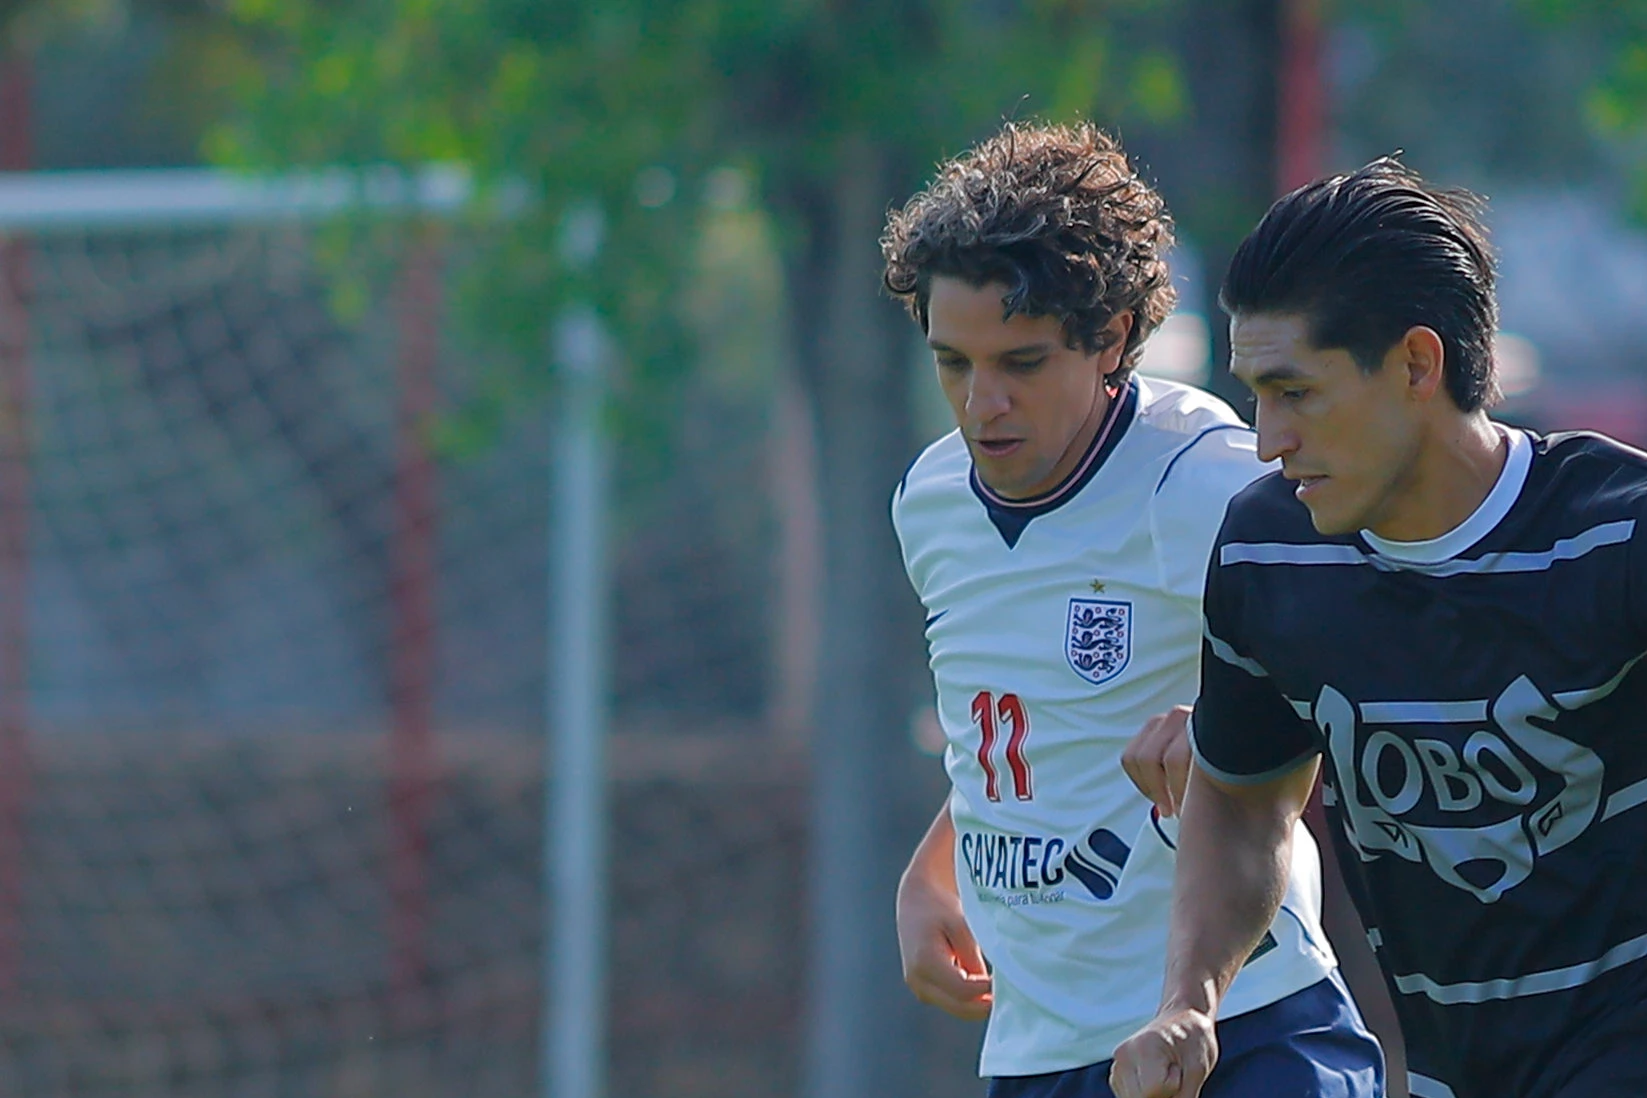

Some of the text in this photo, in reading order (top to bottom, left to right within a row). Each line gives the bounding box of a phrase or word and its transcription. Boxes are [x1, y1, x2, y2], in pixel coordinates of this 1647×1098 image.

[970, 691, 1033, 802] 11
[1315, 673, 1604, 862] LOBOS
[961, 832, 1065, 888] SAYATEC
